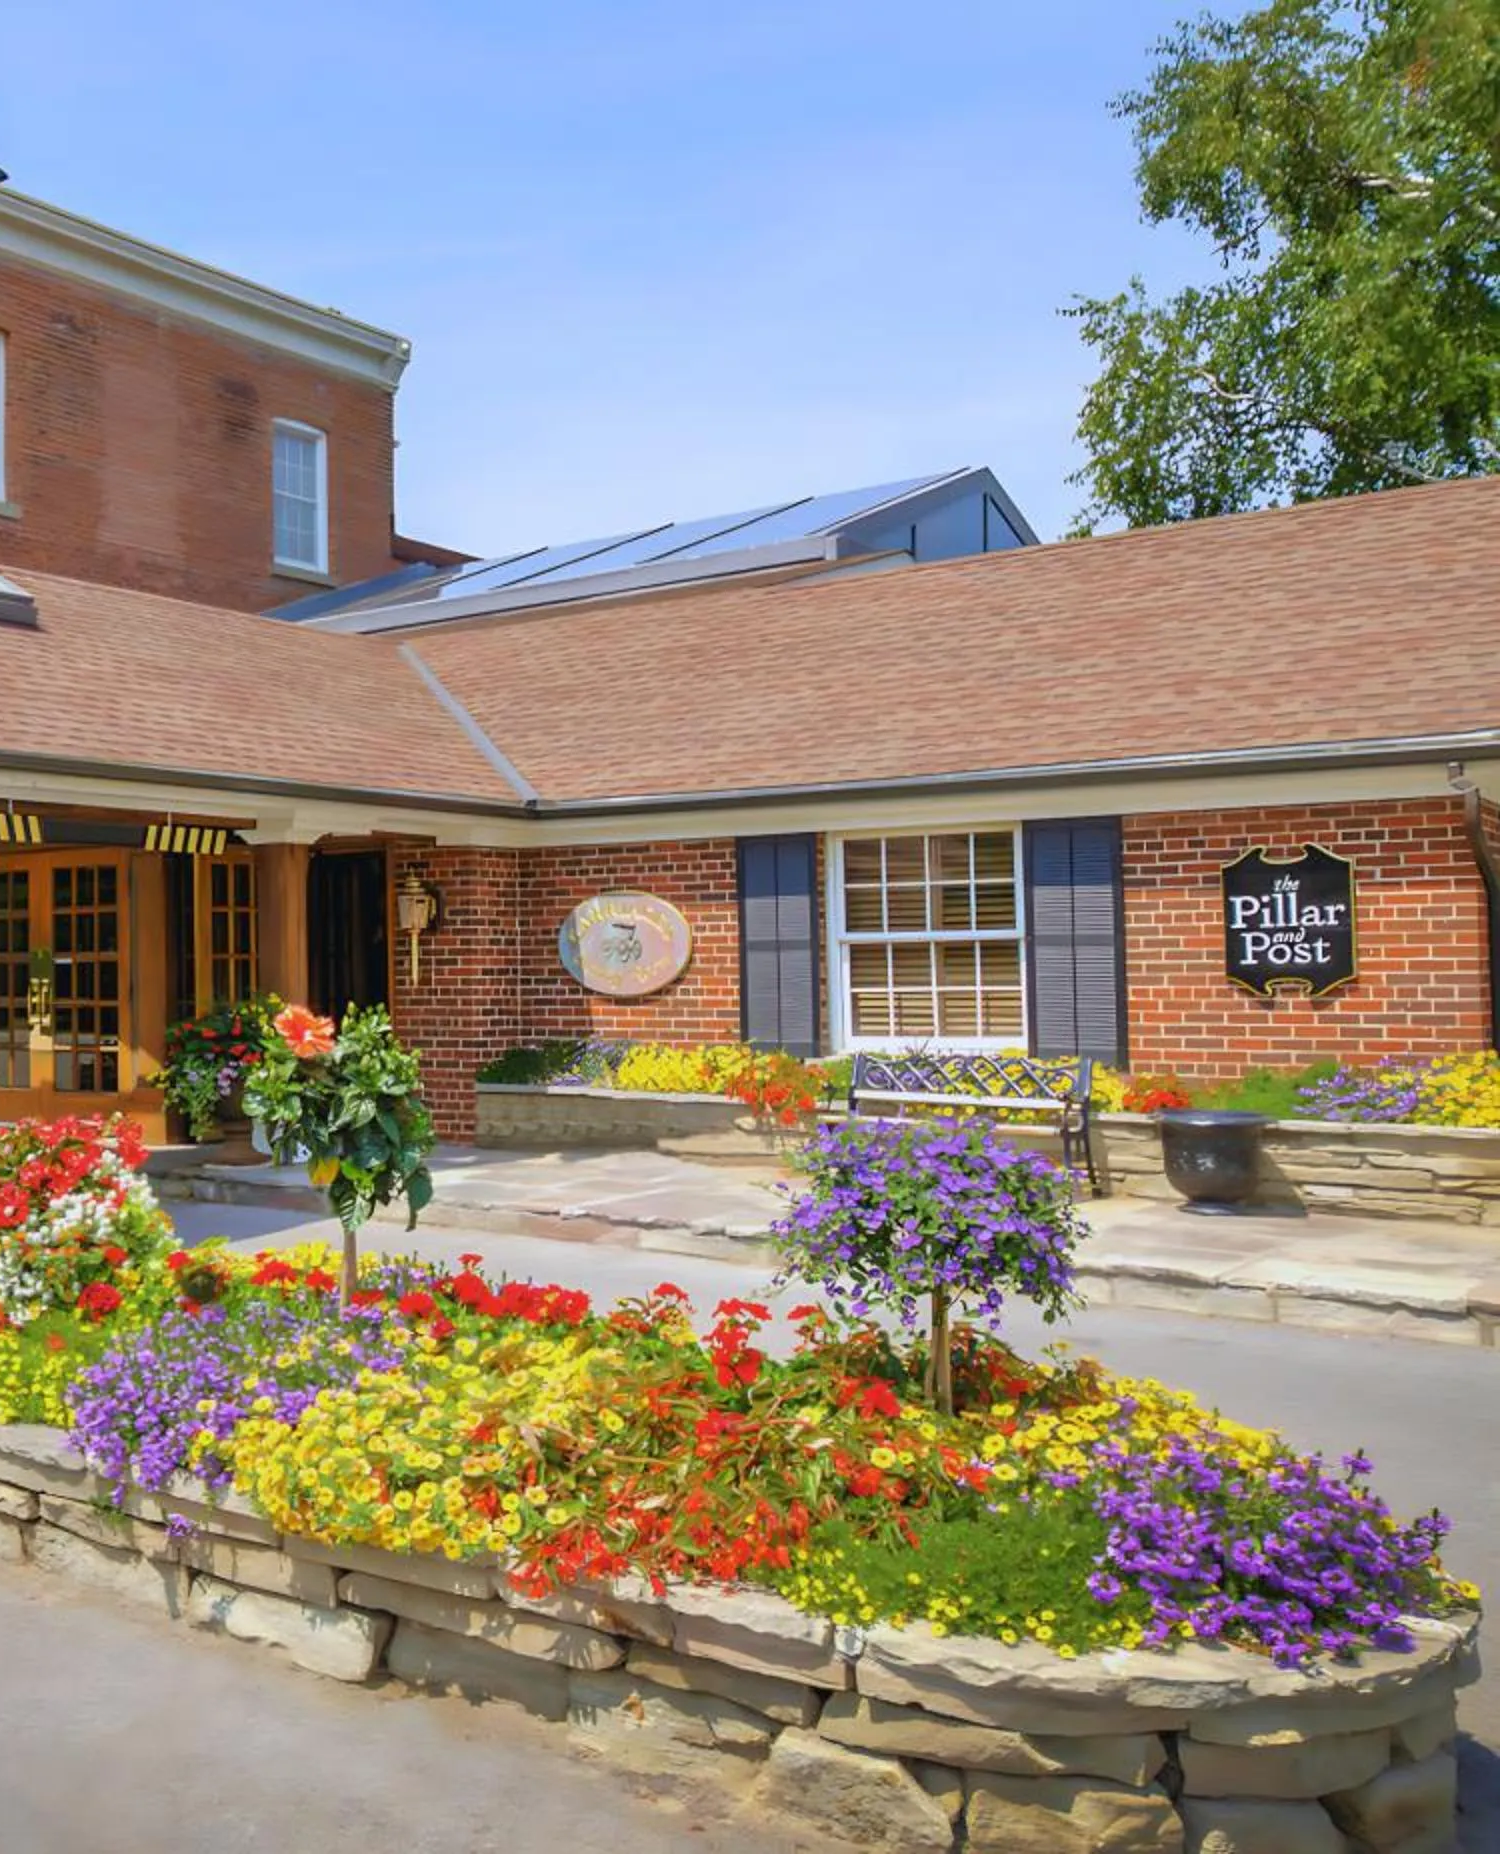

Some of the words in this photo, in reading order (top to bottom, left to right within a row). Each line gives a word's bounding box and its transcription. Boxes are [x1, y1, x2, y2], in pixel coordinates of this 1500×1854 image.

[1273, 874, 1301, 892] the
[1228, 892, 1346, 929] Pillar
[1272, 928, 1306, 943] and
[1240, 932, 1331, 965] Post
